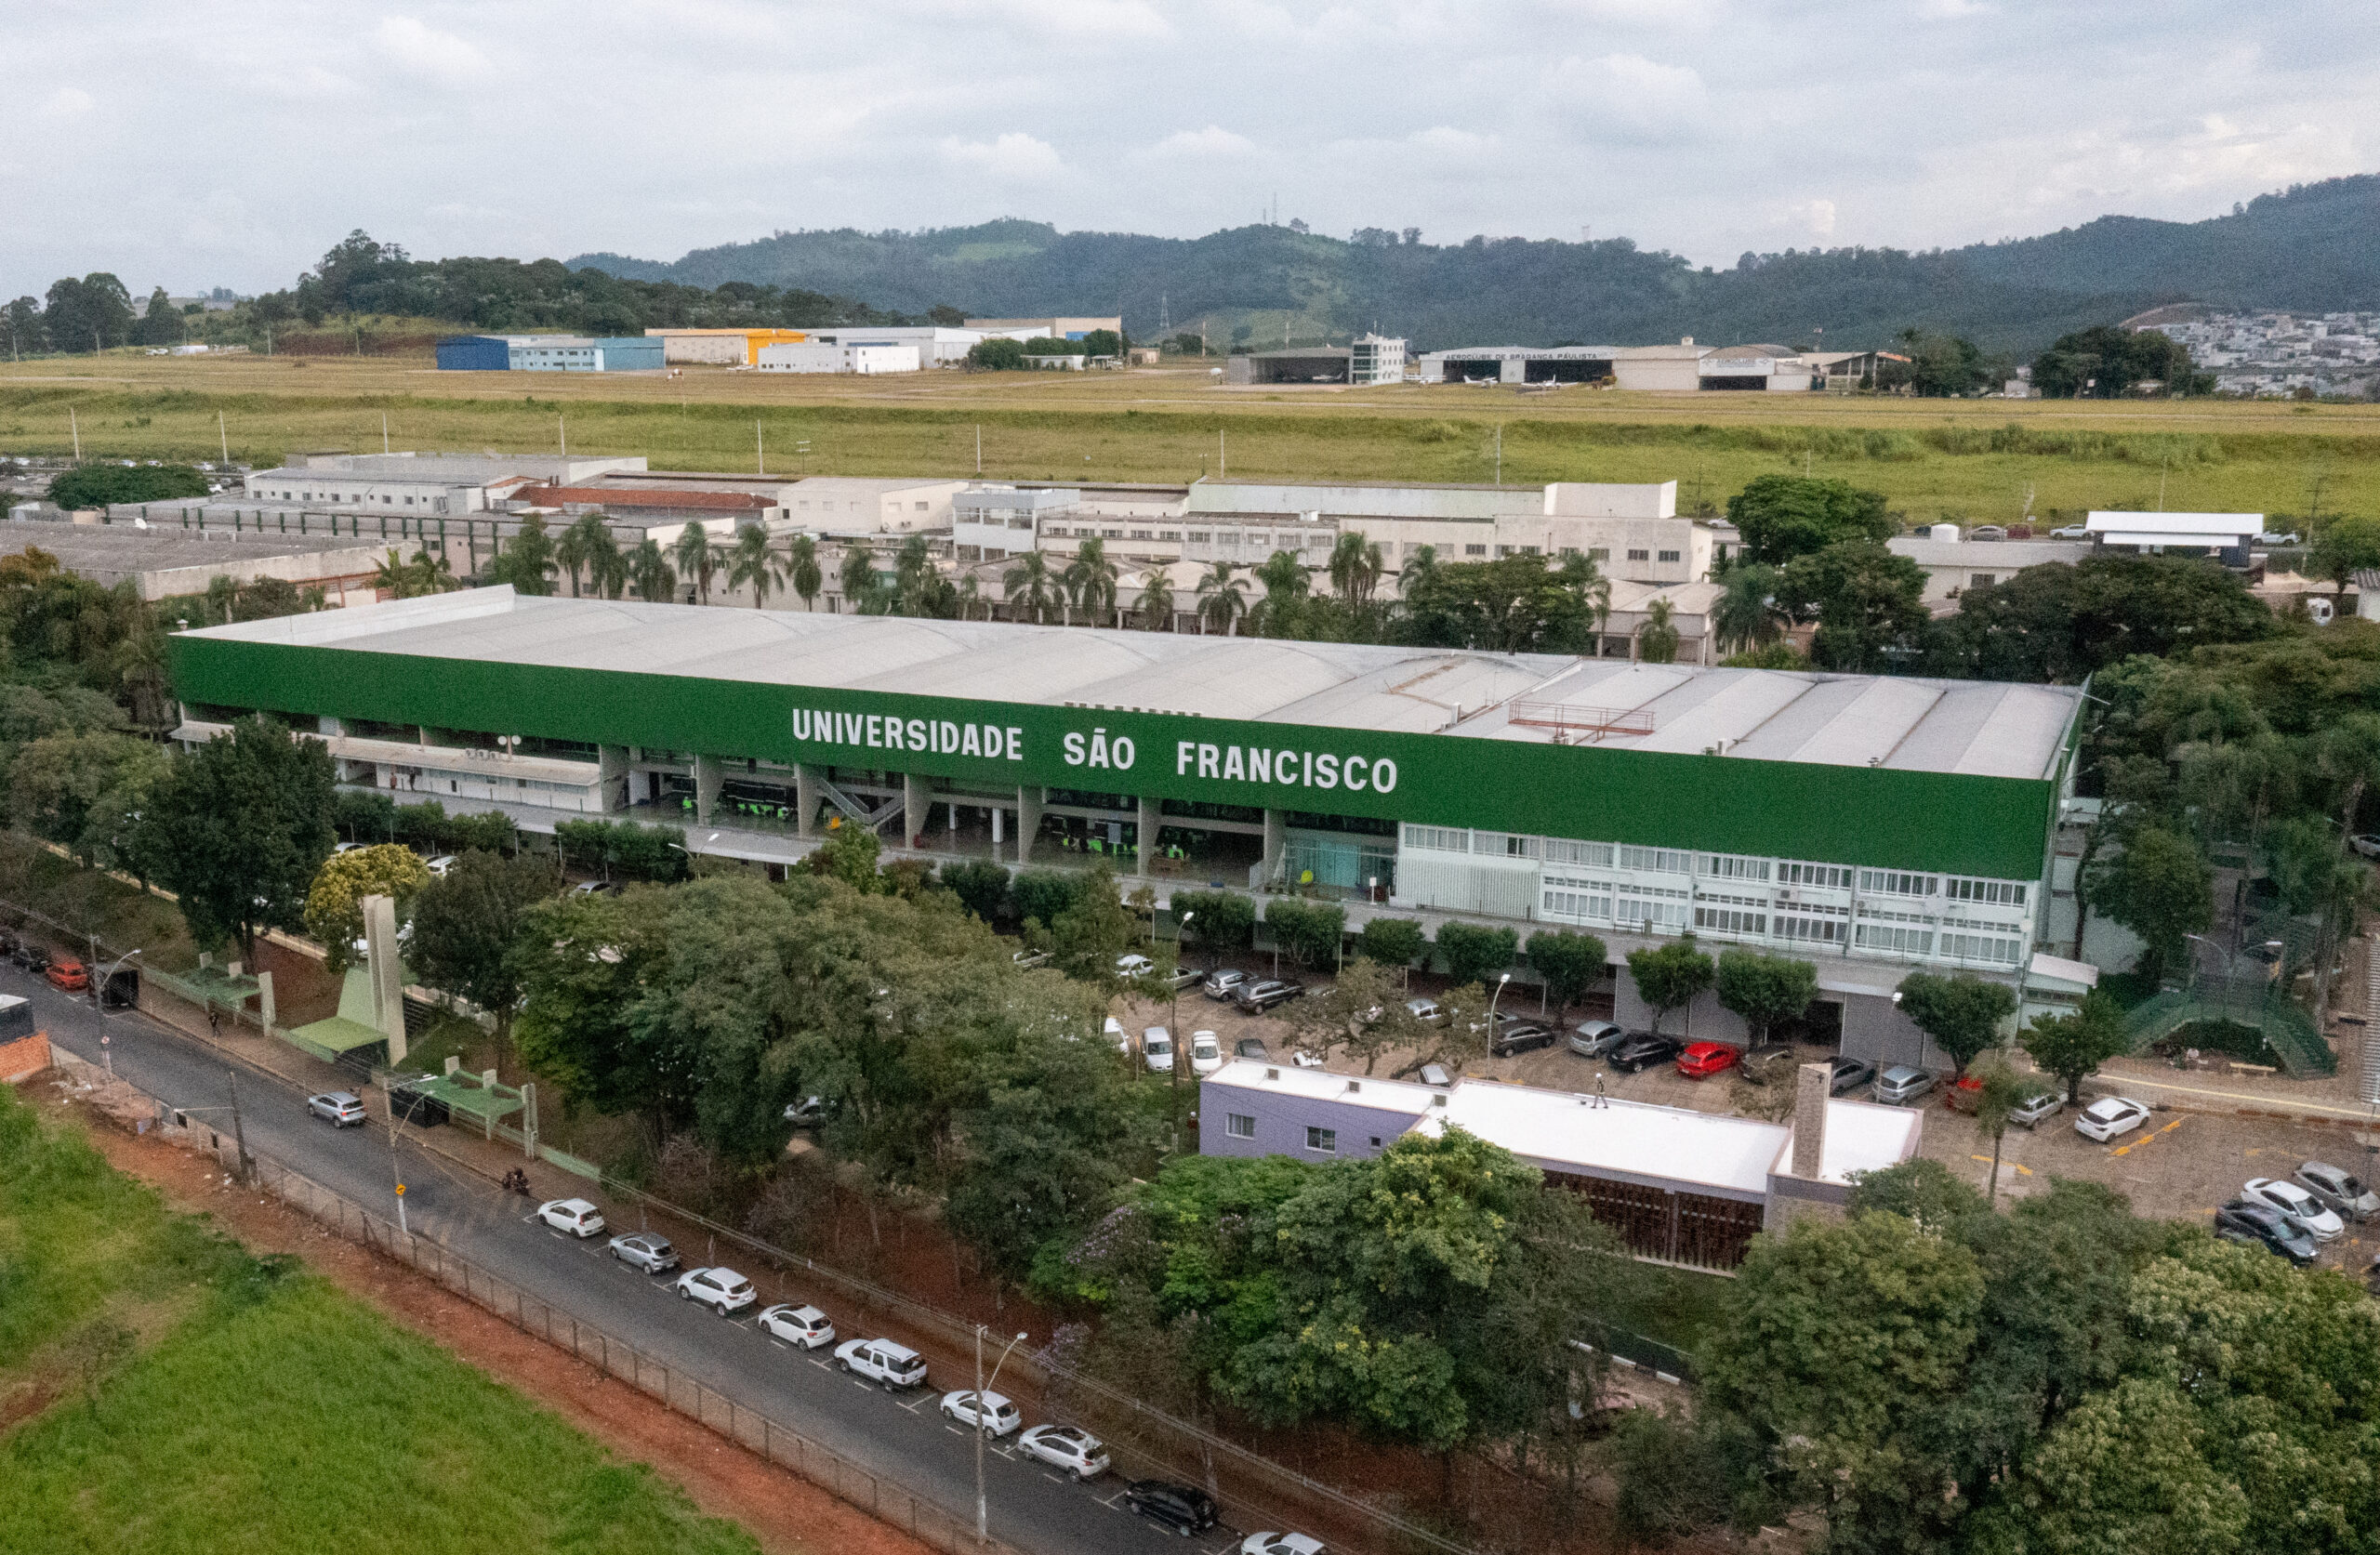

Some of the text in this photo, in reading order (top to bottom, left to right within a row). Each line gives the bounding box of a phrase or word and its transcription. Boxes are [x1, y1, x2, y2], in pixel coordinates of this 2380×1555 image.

[792, 708, 1397, 794] UNIVERSIDADE SÃO FRANCISCO
